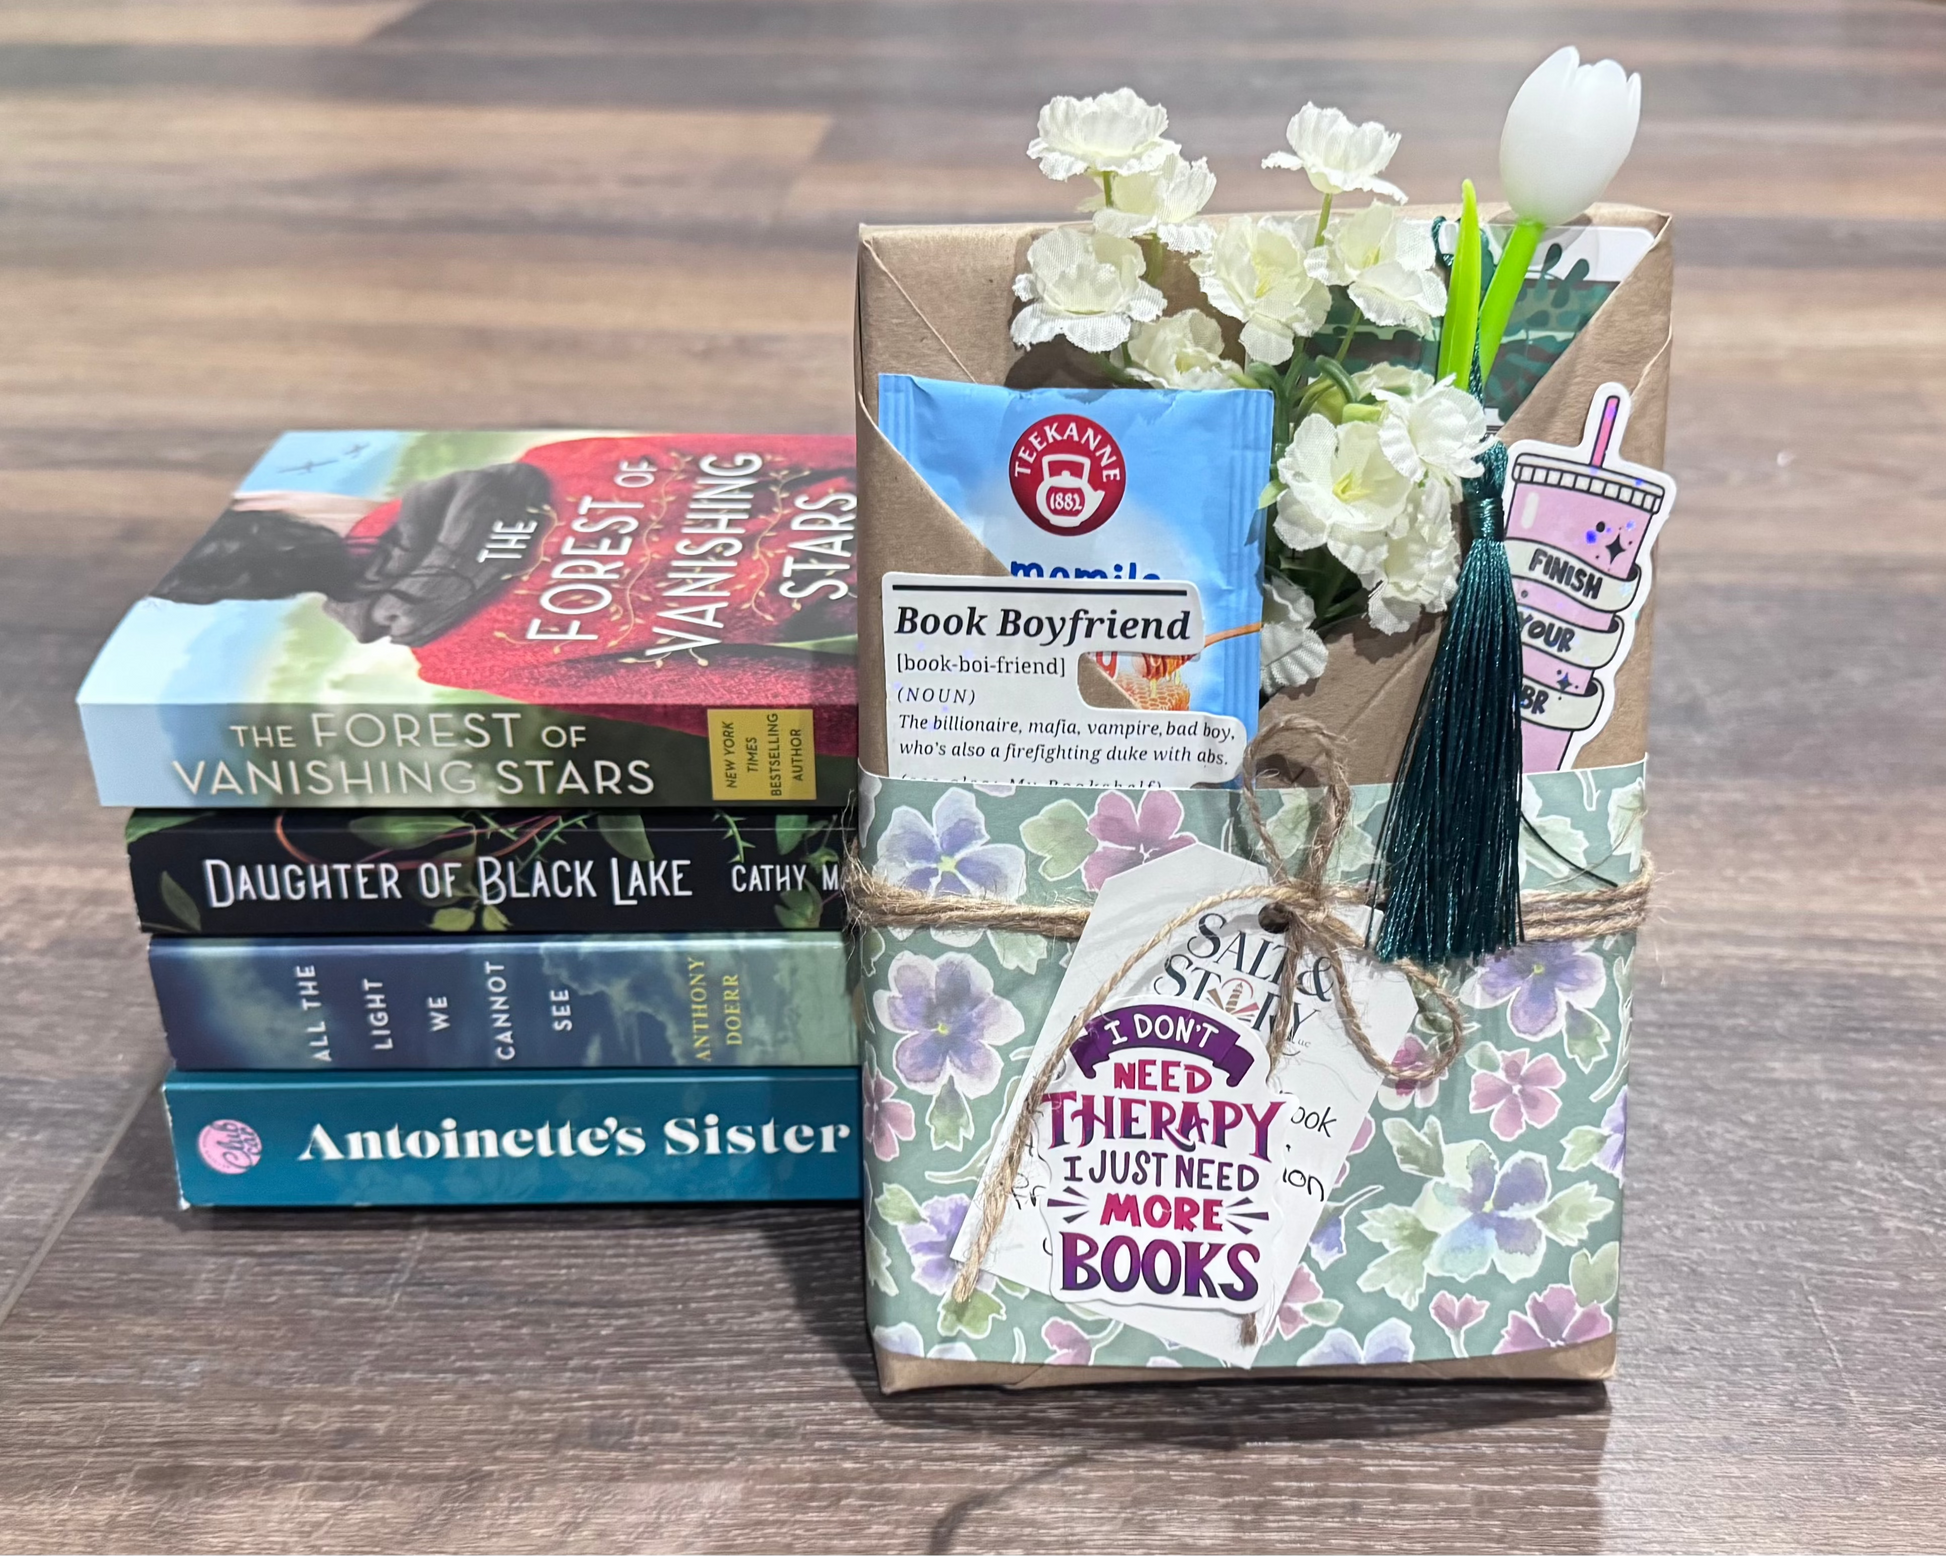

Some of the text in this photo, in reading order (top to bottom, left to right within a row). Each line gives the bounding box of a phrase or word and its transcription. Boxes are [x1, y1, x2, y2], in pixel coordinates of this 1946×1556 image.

[1014, 421, 1121, 483] TEEKANNE
[1049, 491, 1083, 512] 1882
[477, 520, 538, 563] THE
[525, 457, 660, 641] FOREST OF
[645, 453, 763, 657] VANISHING
[779, 492, 857, 600] STARS
[1529, 548, 1603, 600] FINISH
[894, 605, 1191, 648] Book Boyfriend
[897, 653, 1066, 678] [book-boi-friend]
[897, 687, 976, 706] (NOUN)
[1521, 685, 1550, 715] BR
[229, 712, 587, 748] THE FOREST OF
[899, 714, 1235, 743] The billionaire, mafia, vampire, bad boy,
[722, 721, 737, 788] NEW YORK
[746, 737, 759, 773] TIMES
[767, 713, 782, 796] BESTSELLING
[790, 729, 803, 781] AUTHOR
[900, 740, 1228, 765] who's also a firefighting duke with abs.
[172, 760, 654, 795] VANISHING STARS
[203, 856, 693, 908] DAUGHTER OF BLACK LAKE
[731, 864, 839, 892] CATHY M
[296, 965, 332, 1062] ALL THE
[362, 978, 393, 1050] LIGHT
[426, 996, 450, 1032] WE
[485, 961, 515, 1060] CANNOT
[550, 989, 572, 1031] SEE
[688, 957, 711, 1062] ANTHONY
[723, 974, 743, 1045] DOERR
[1103, 1012, 1220, 1049] I DON'T
[1113, 1059, 1212, 1094] NEED
[298, 1113, 850, 1162] Antoinette's Sister
[1043, 1094, 1286, 1163] THERAPY
[1290, 1106, 1337, 1138] ook
[1063, 1150, 1260, 1192] I JUST NEED
[1100, 1193, 1225, 1233] MORE
[1059, 1231, 1261, 1302] BOOKS
